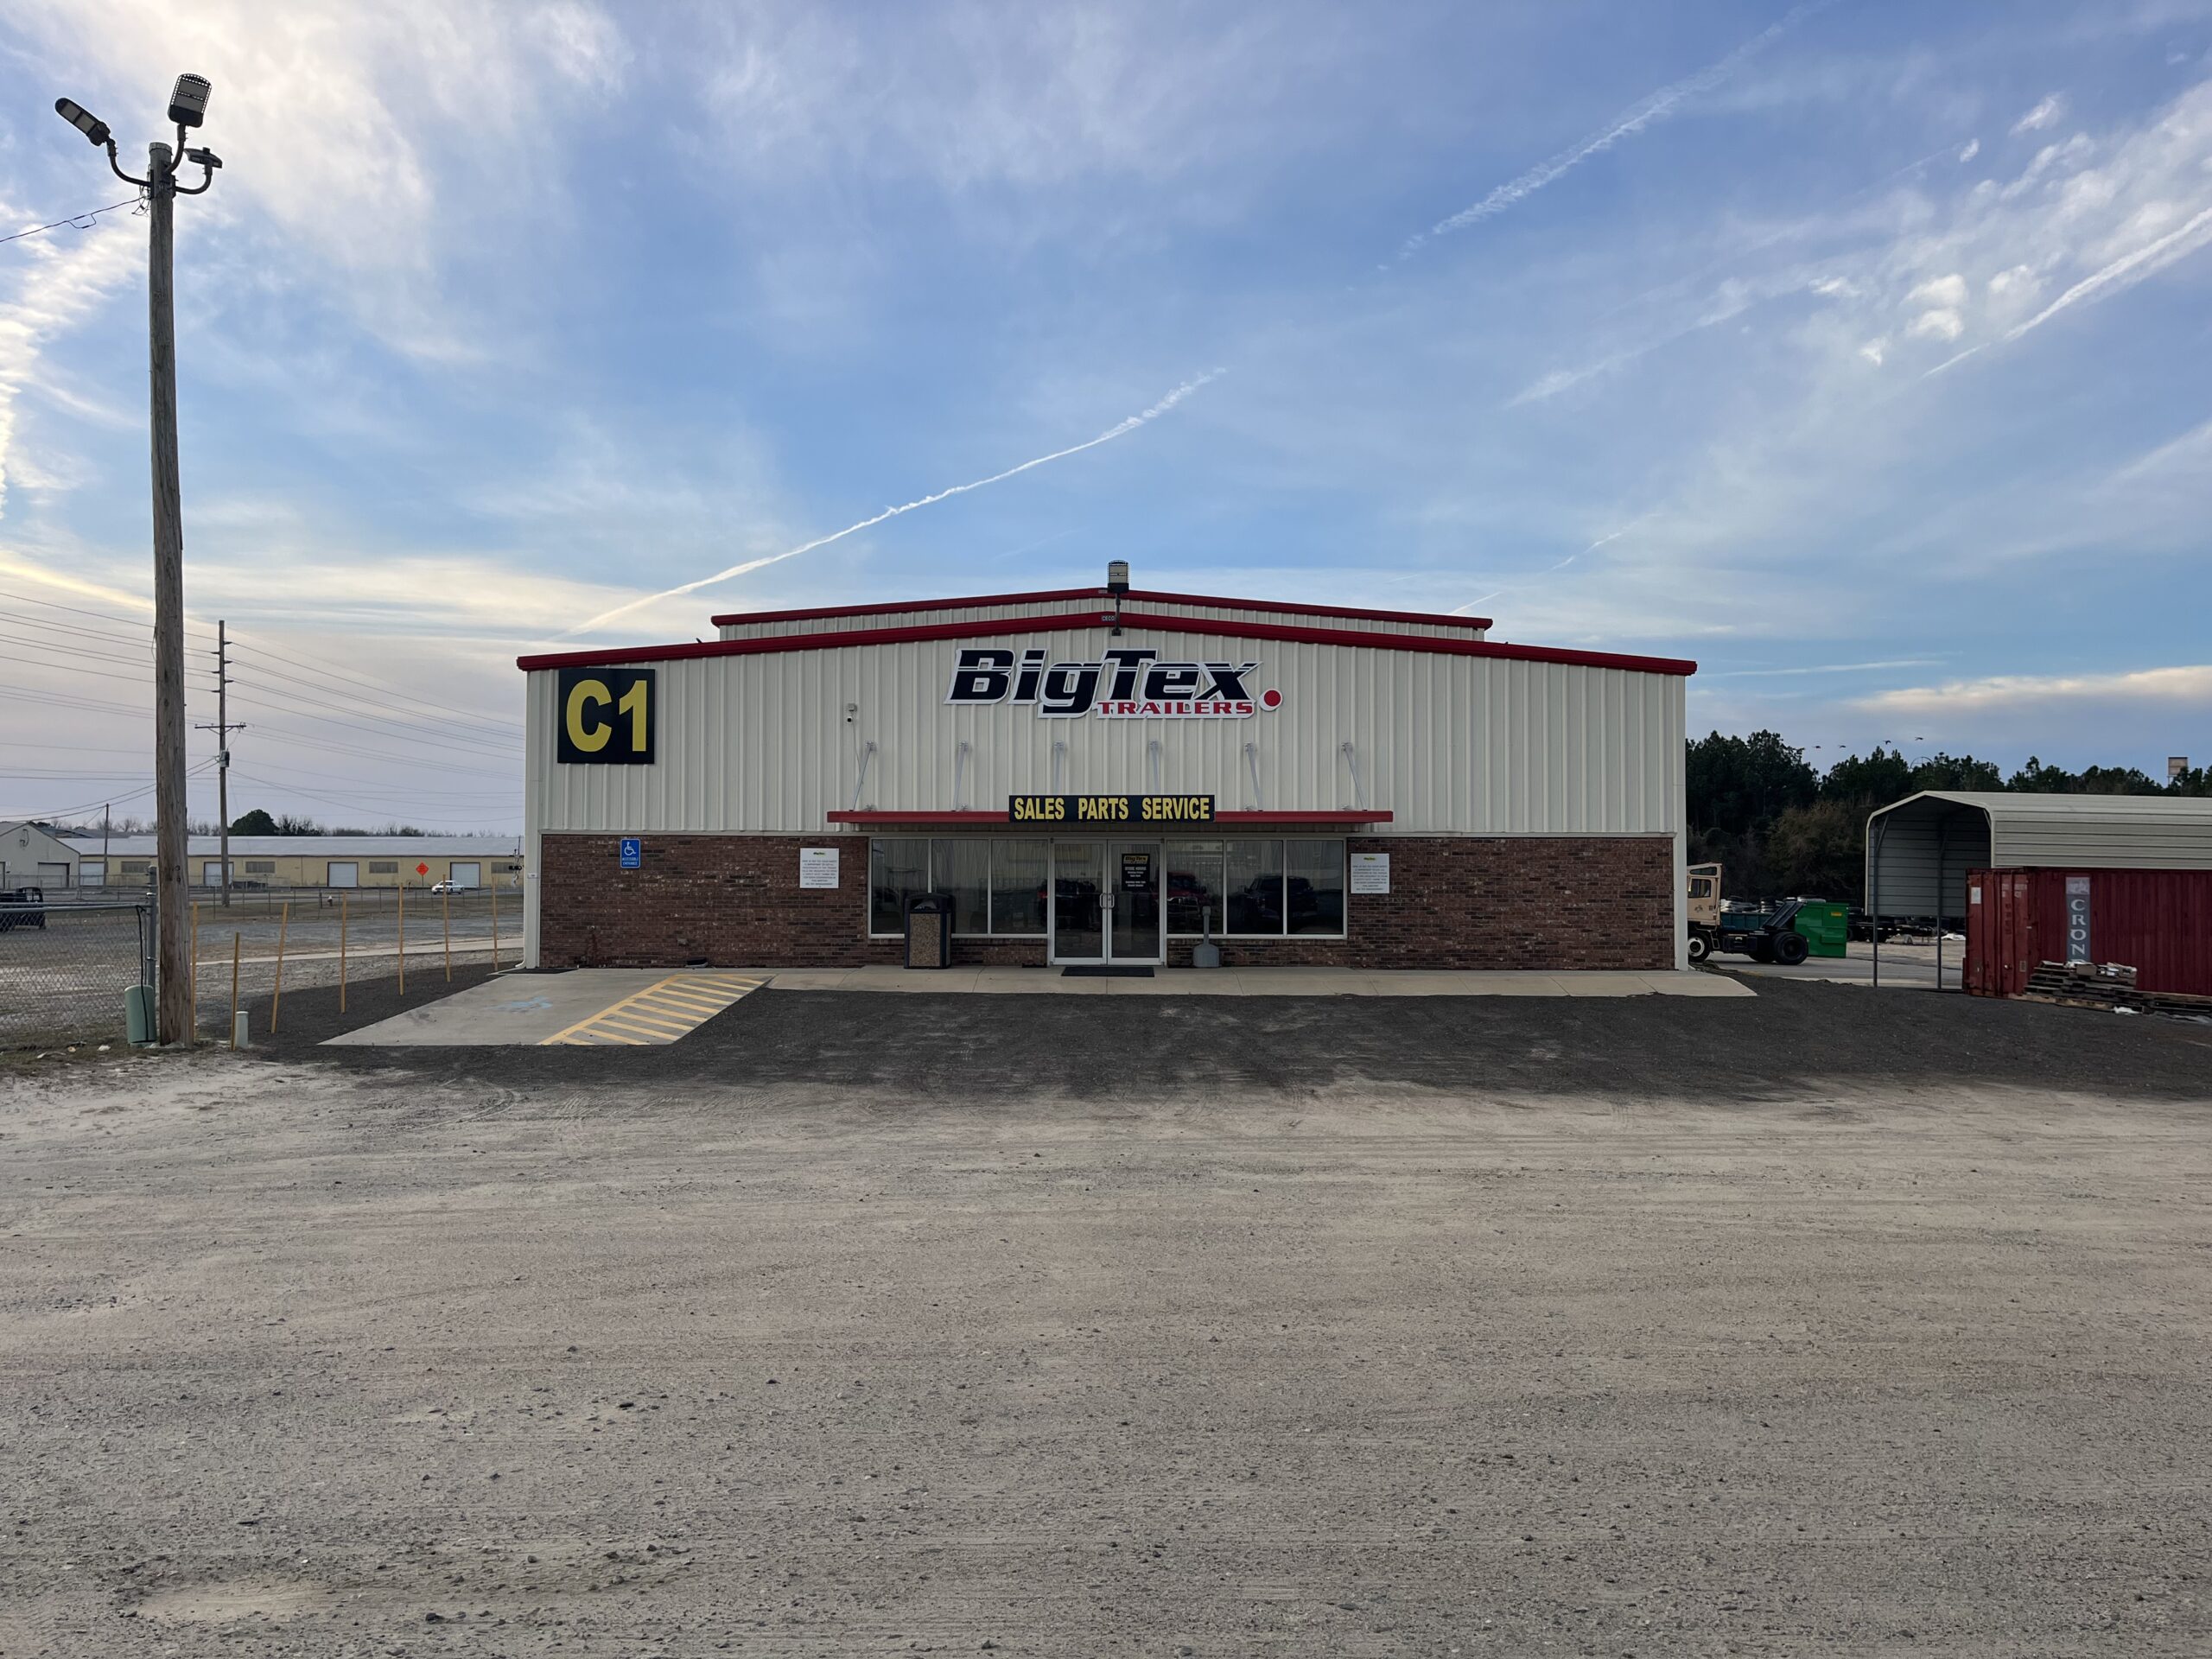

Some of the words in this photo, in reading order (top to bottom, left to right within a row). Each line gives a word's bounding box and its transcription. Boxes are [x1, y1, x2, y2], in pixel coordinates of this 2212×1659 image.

[566, 679, 647, 752] C1
[1097, 702, 1253, 715] TRAILERS
[1014, 798, 1065, 820] SALES
[1078, 798, 1128, 820] PARTS
[1141, 798, 1210, 820] SERVICE
[2070, 899, 2087, 963] CRON
